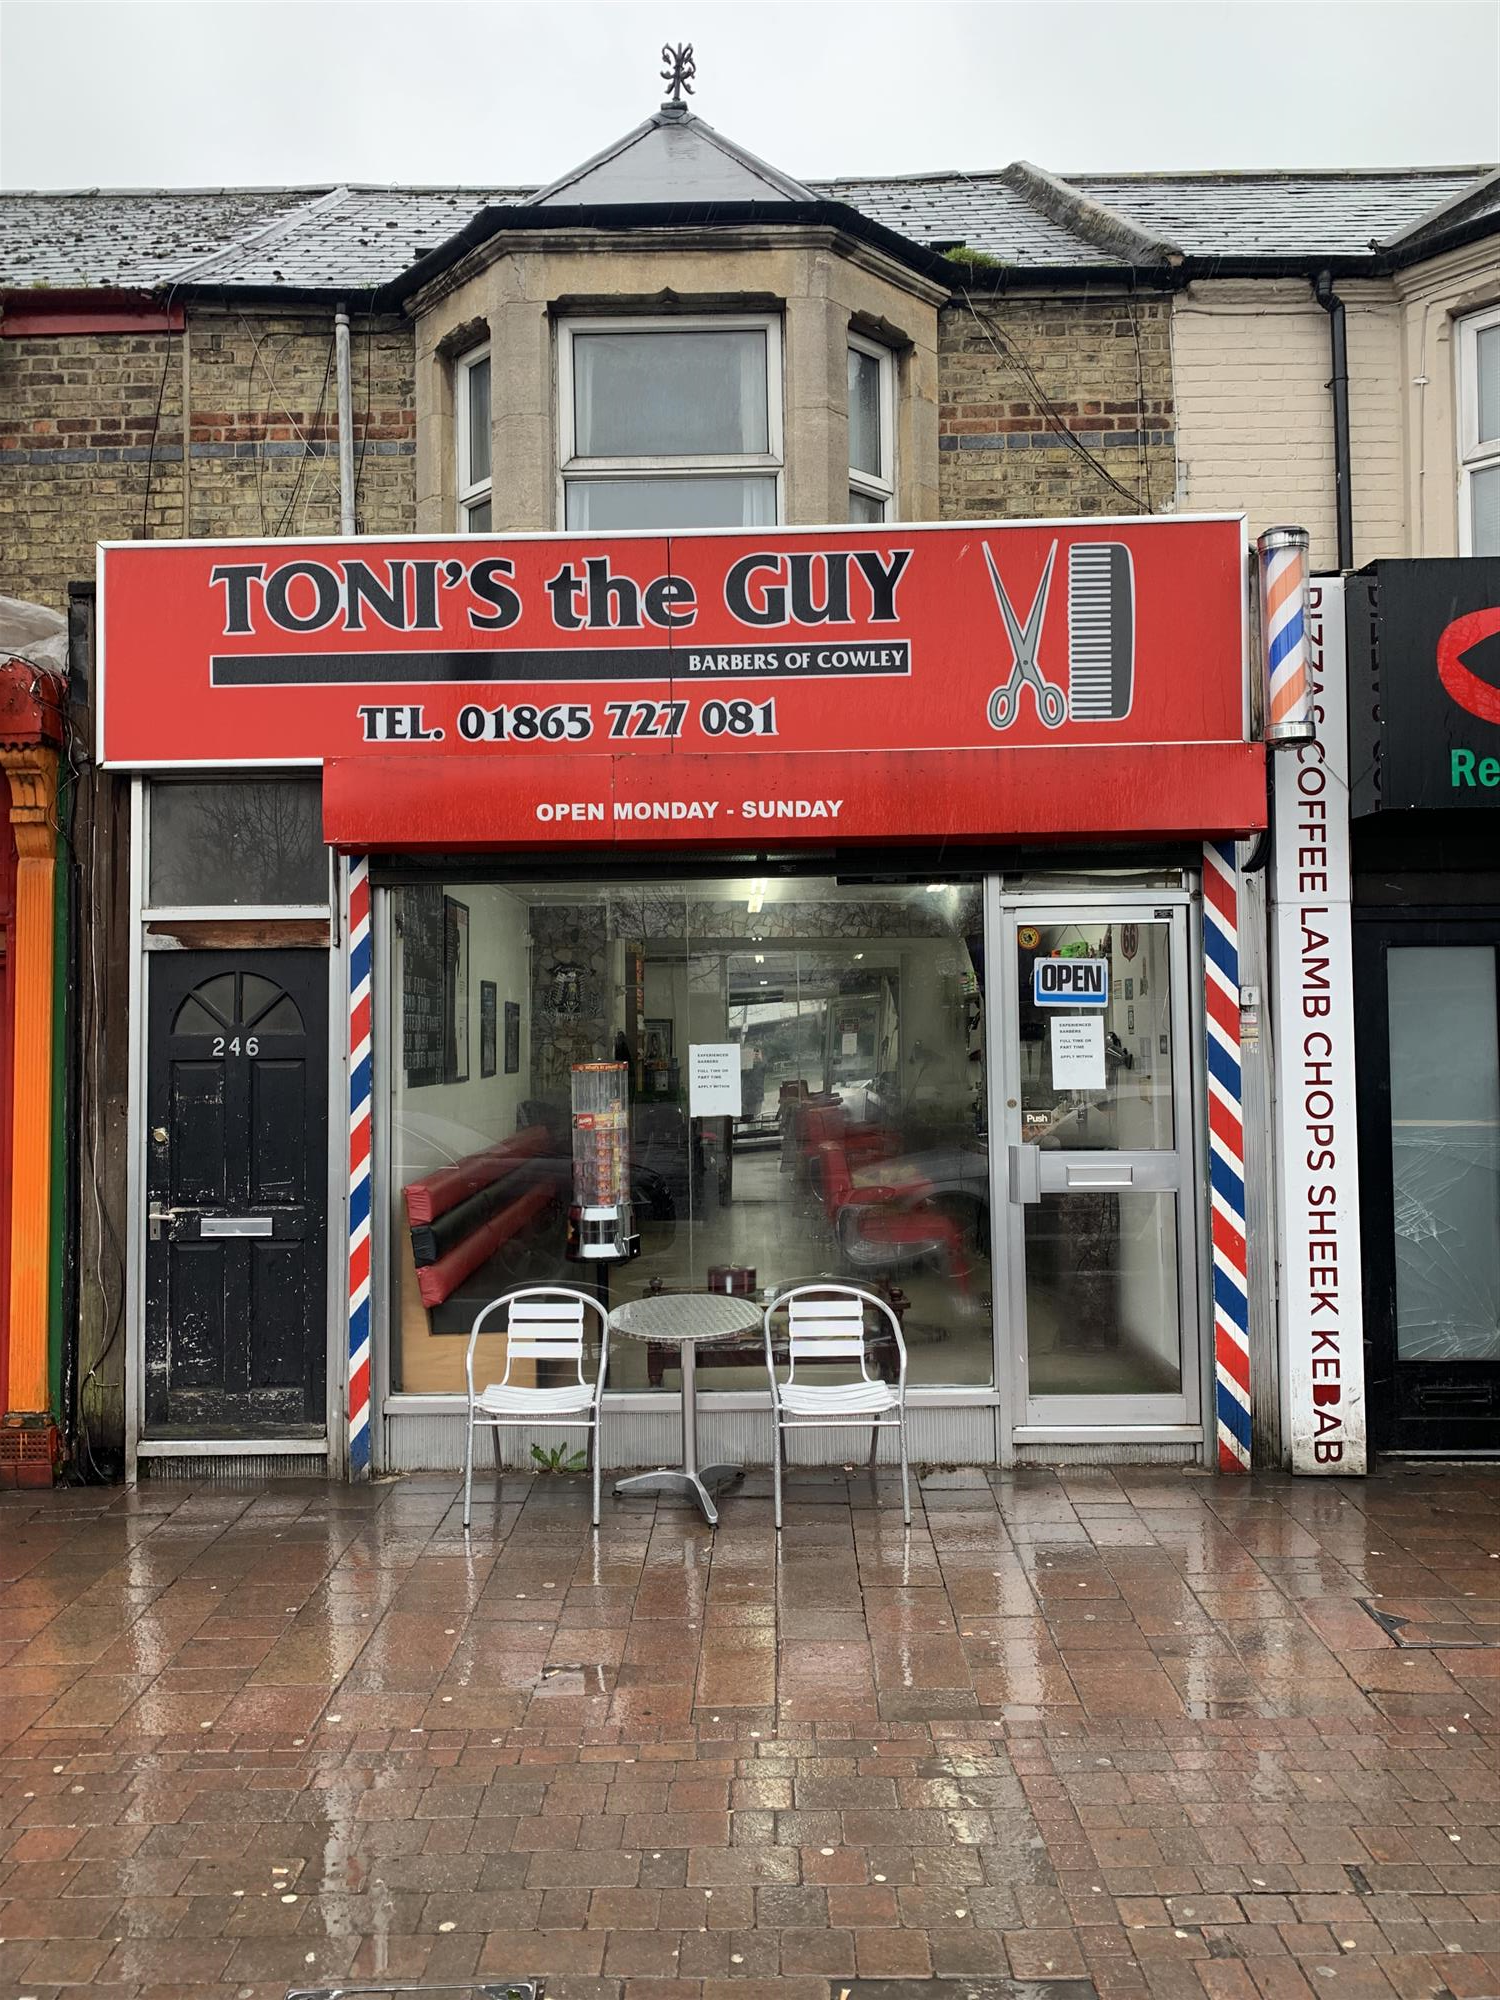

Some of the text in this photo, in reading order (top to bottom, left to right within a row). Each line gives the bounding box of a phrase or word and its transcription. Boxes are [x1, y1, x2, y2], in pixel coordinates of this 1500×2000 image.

[209, 549, 914, 636] TONI'S the GUY
[689, 650, 906, 672] BARBERS OF COWLEY
[357, 697, 778, 742] TEL. 01865 727 081
[536, 803, 605, 823] OPEN
[613, 802, 720, 821] MONDAY
[741, 800, 844, 819] SUNDAY
[1297, 740, 1328, 893] COFFEE
[1041, 964, 1102, 993] OPEN
[1301, 907, 1331, 1018] LAMB
[212, 1036, 259, 1057] 246
[1026, 1113, 1048, 1123] Push
[1304, 1031, 1336, 1171] CHOPS
[1308, 1184, 1339, 1316] SHEEK
[1312, 1330, 1343, 1464] KEBAB
